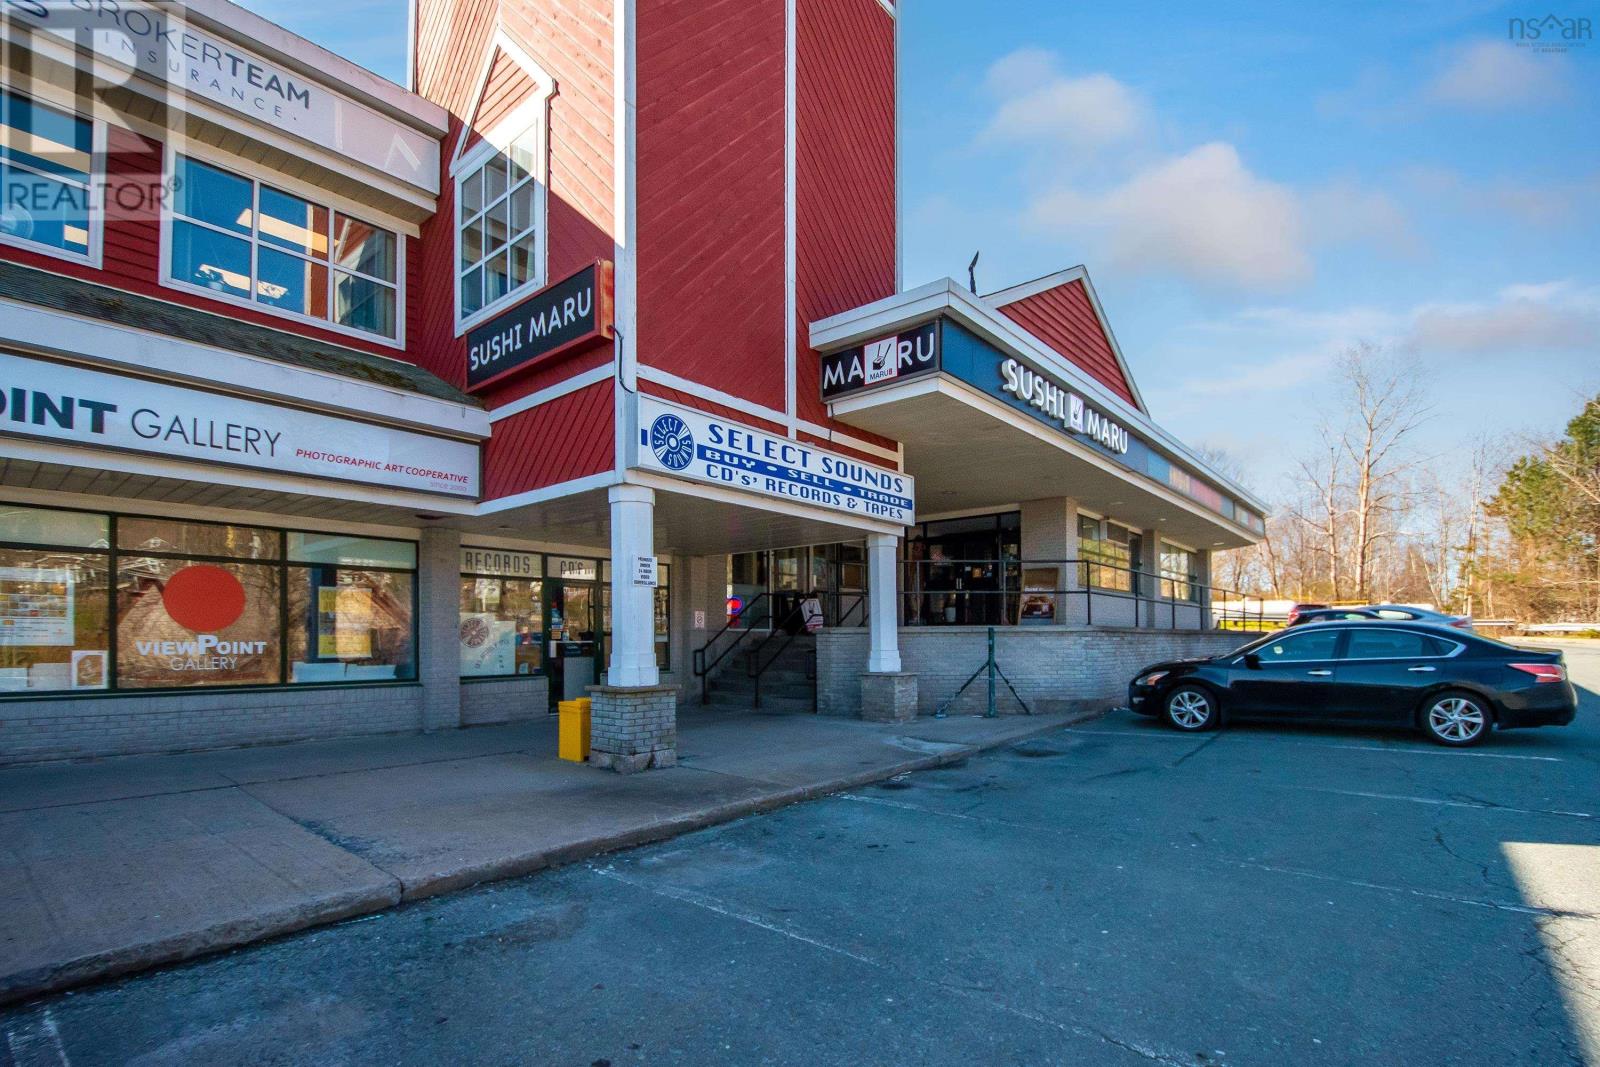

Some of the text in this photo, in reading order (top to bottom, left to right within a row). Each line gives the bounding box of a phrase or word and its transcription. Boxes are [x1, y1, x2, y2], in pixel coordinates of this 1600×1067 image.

[471, 287, 591, 371] SUSHI MARU
[1001, 358, 1128, 454] SUSHI MARU
[131, 408, 281, 457] GALLERY
[295, 448, 469, 484] PHOTOGRAPHIC ART COOPERATIVE
[705, 448, 910, 508] BUY SELL TRADE
[708, 423, 903, 493] SELECT SOUNDS
[765, 477, 840, 506] RECORDS
[846, 497, 858, 509] &
[863, 500, 903, 519] TAPES
[465, 551, 530, 574] RECORDS
[170, 656, 239, 672] GALLERY
